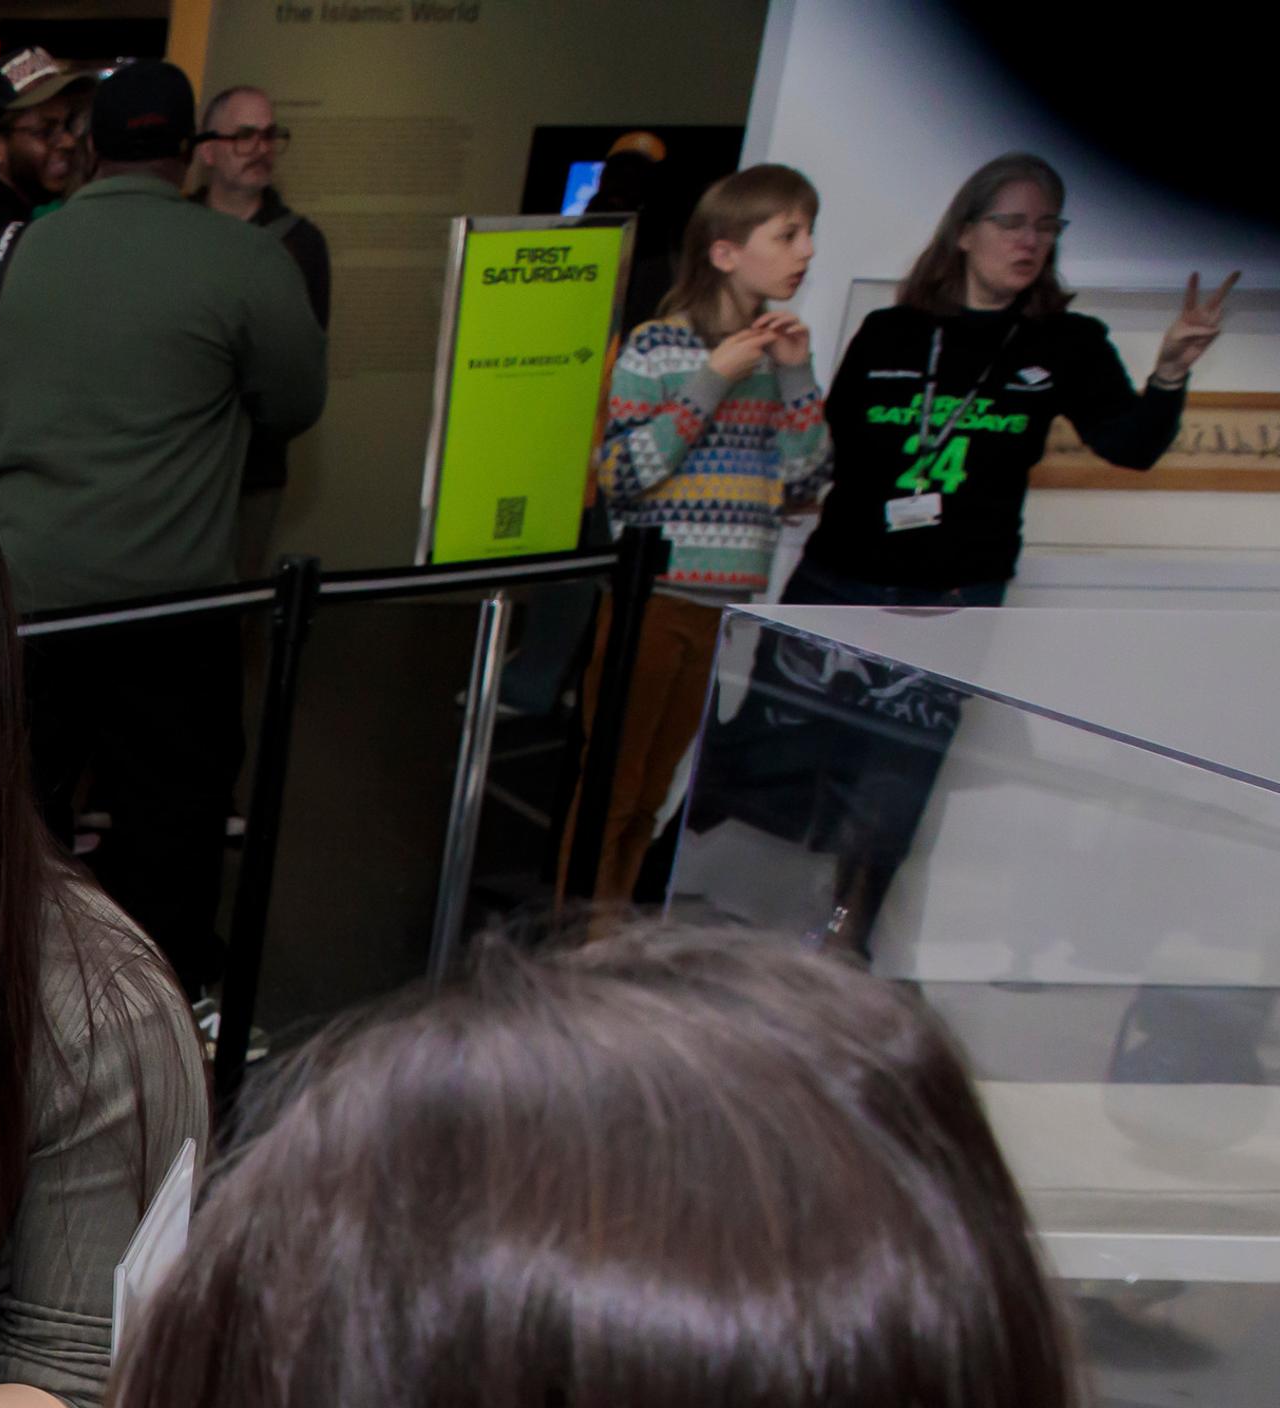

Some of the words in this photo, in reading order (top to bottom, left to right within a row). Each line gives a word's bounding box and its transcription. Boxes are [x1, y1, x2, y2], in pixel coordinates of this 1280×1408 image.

[276, 3, 313, 23] the
[320, 1, 404, 23] Islamic
[411, 0, 480, 23] World
[515, 245, 572, 265] FIRST
[481, 265, 599, 285] SATURDAYS
[896, 434, 971, 494] 24
